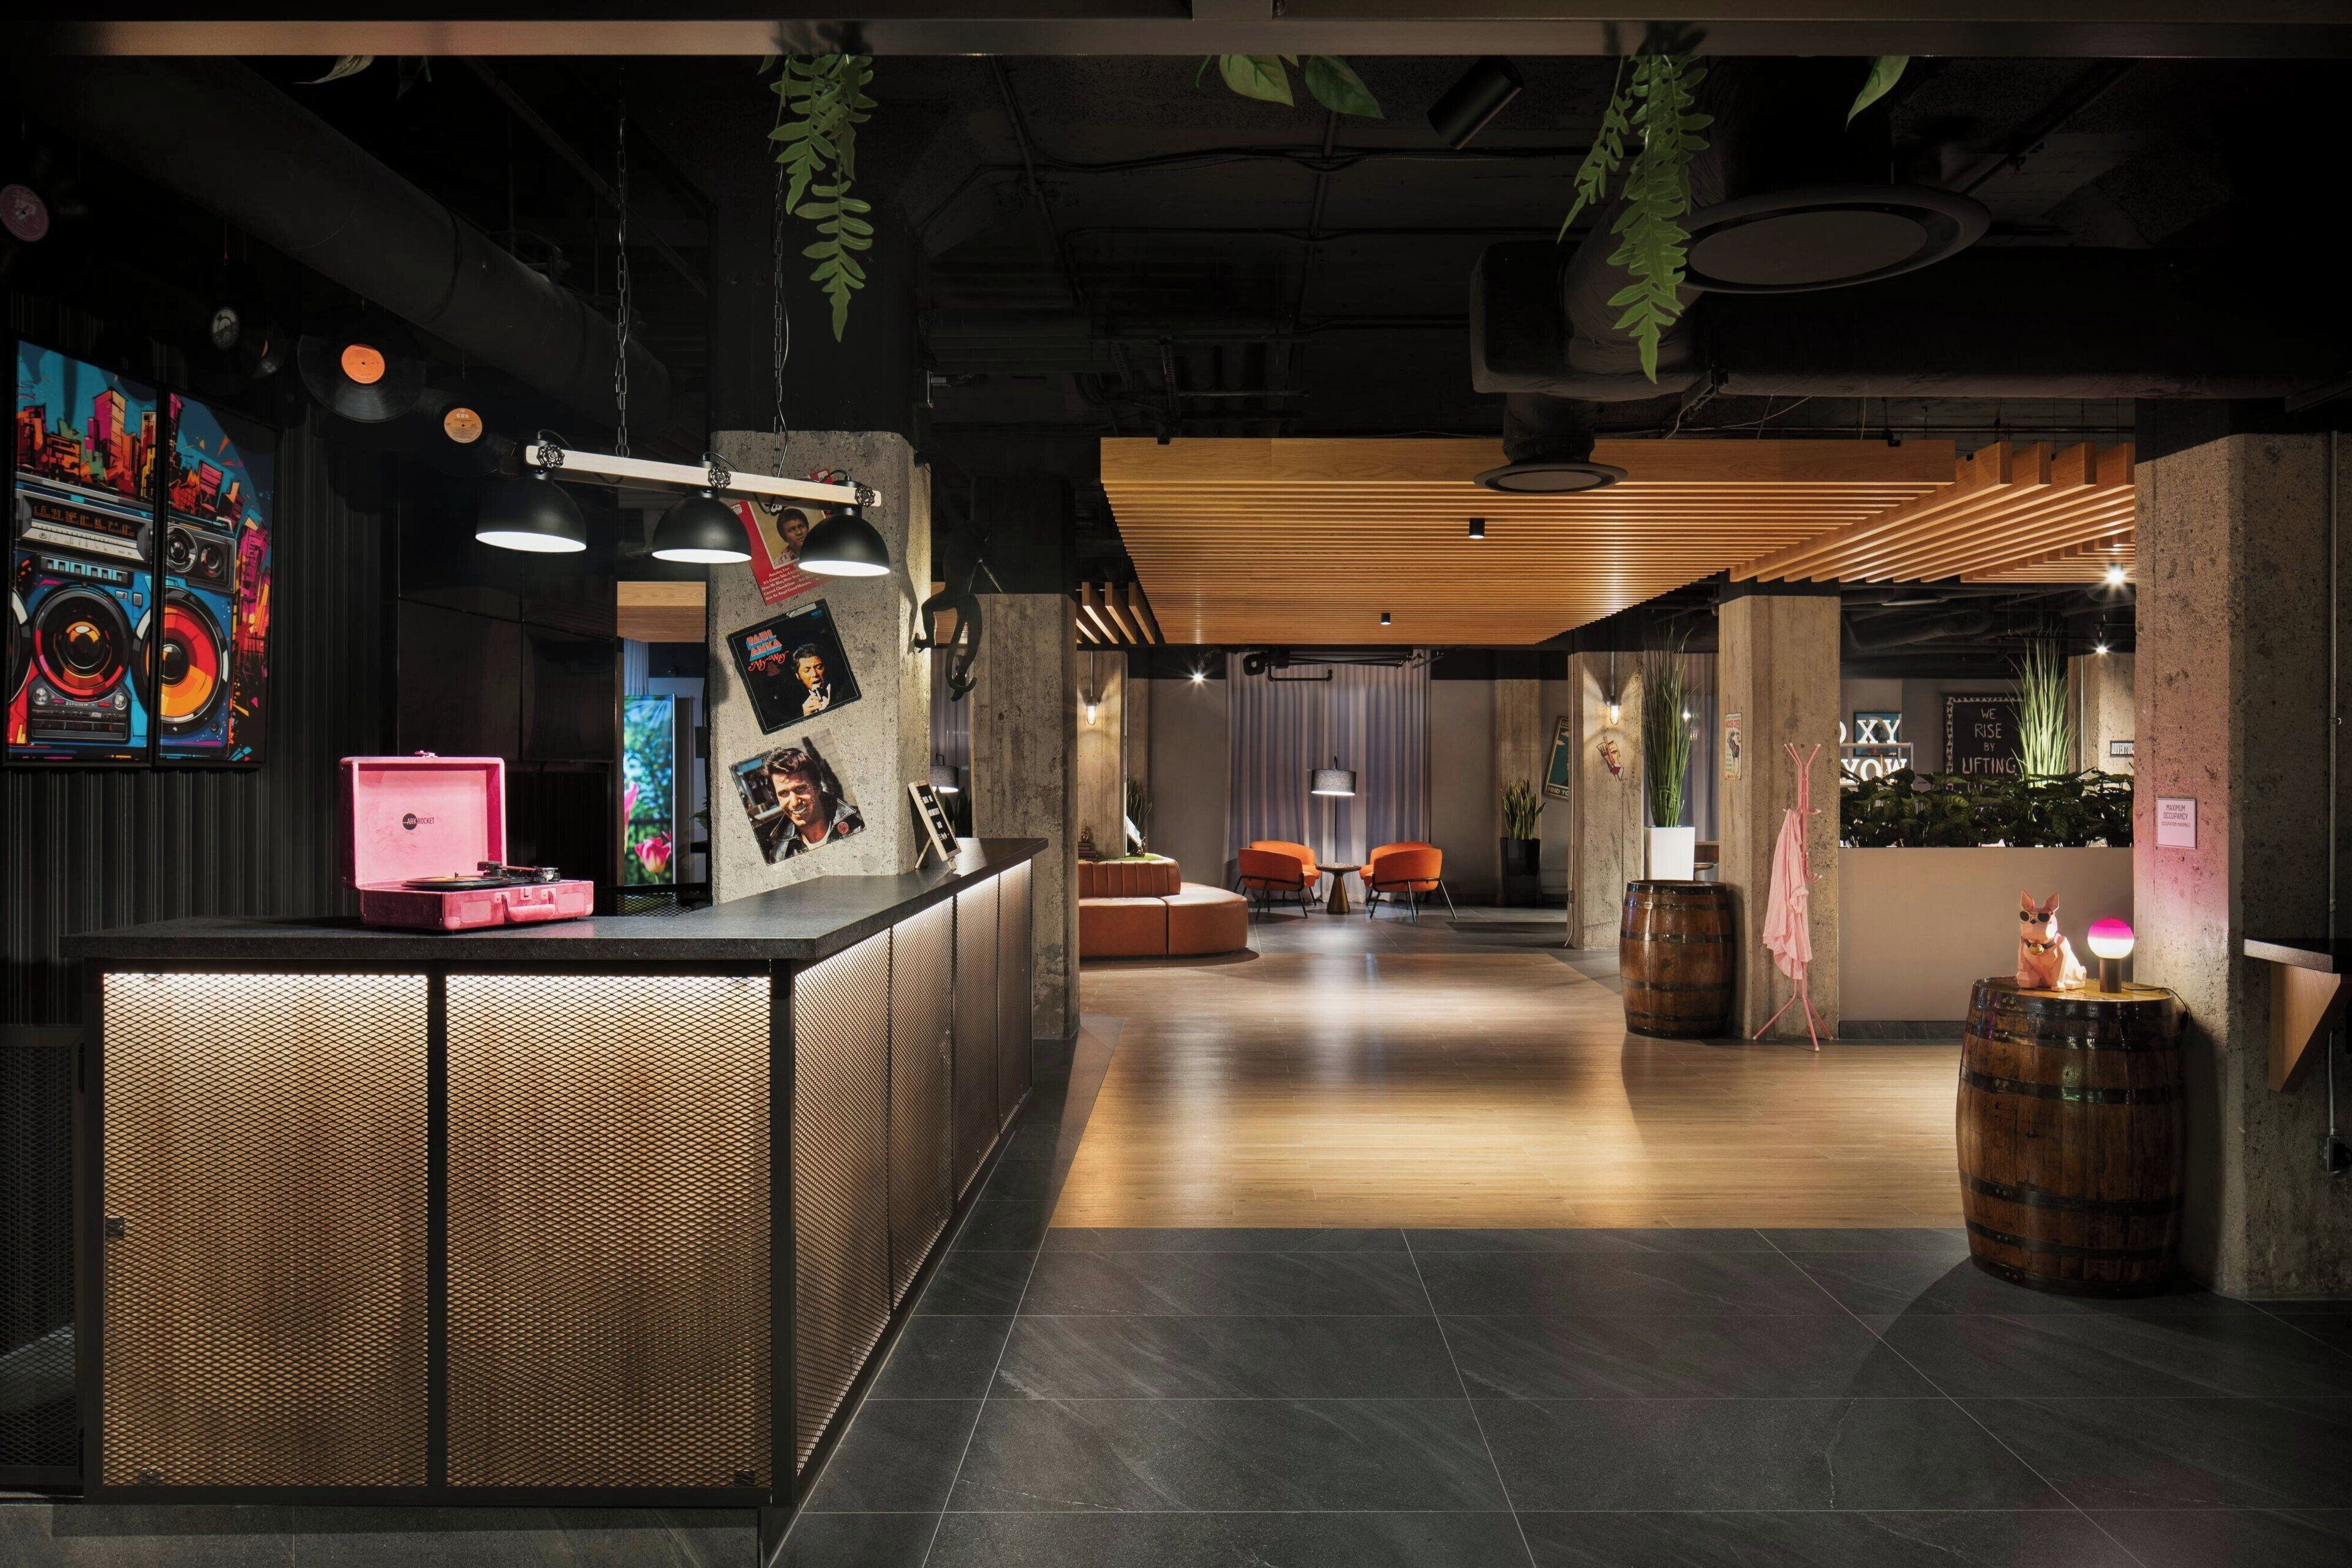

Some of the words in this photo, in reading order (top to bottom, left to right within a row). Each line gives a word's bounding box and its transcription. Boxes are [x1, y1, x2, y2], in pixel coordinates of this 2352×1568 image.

[746, 629, 777, 650] PAUL
[749, 639, 782, 662] ANKA
[748, 659, 768, 671] My
[767, 651, 789, 664] Way
[1981, 708, 1997, 720] WE
[1839, 720, 1901, 744] XY
[1975, 723, 2002, 739] RISE
[1984, 742, 1996, 752] BY
[1962, 757, 2016, 774] LIFTING
